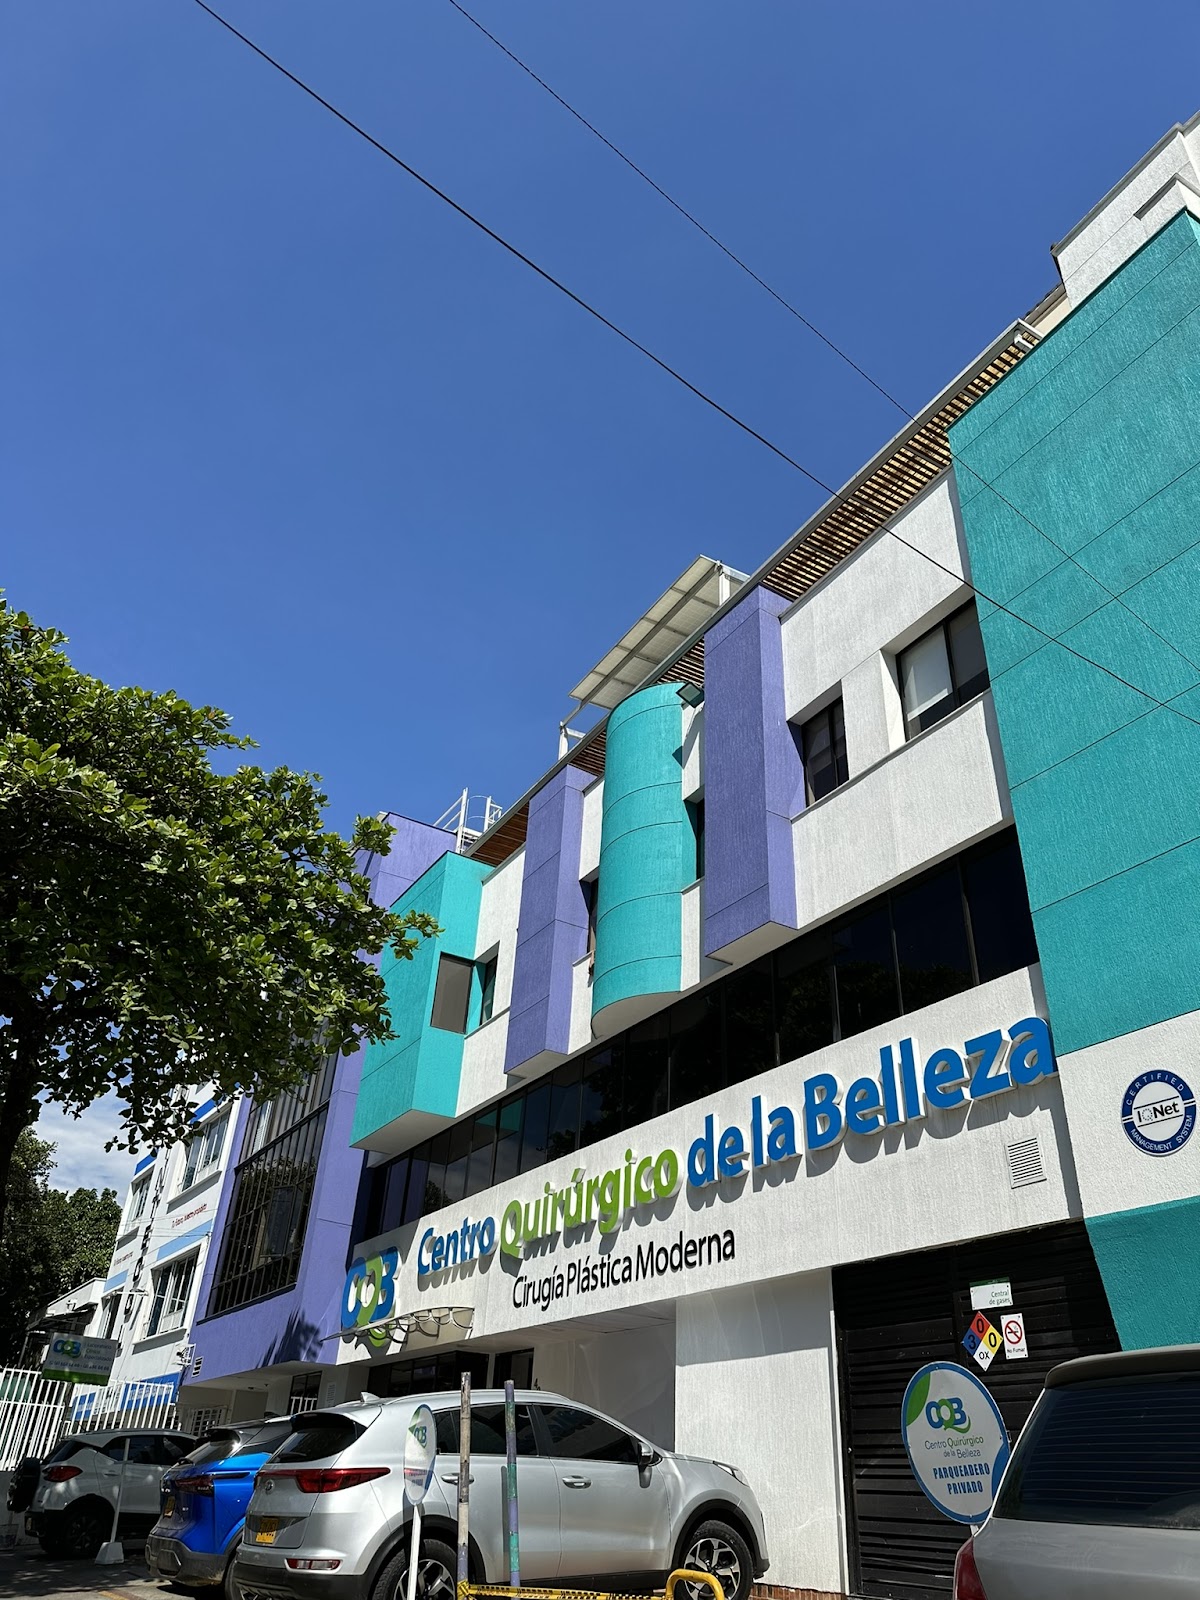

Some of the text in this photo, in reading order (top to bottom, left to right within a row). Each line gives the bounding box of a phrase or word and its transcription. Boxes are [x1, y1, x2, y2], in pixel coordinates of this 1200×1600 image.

[1126, 1073, 1184, 1106] CERTIFIED
[1131, 1114, 1193, 1151] MANAGEMENT SYSTEM
[418, 1017, 1057, 1276] Centro Quirúrgico de la Belleza
[512, 1229, 736, 1312] Cirugía Plástica Moderna
[991, 1289, 1009, 1298] Central
[976, 1318, 985, 1334] 0
[968, 1334, 976, 1350] 3
[988, 1332, 997, 1348] 0
[978, 1351, 990, 1360] OX
[924, 1435, 984, 1450] Centro Quirúrgico
[956, 1448, 981, 1459] Belleza
[932, 1462, 990, 1479] PARQUEADERO
[947, 1480, 984, 1495] PRIVADO
